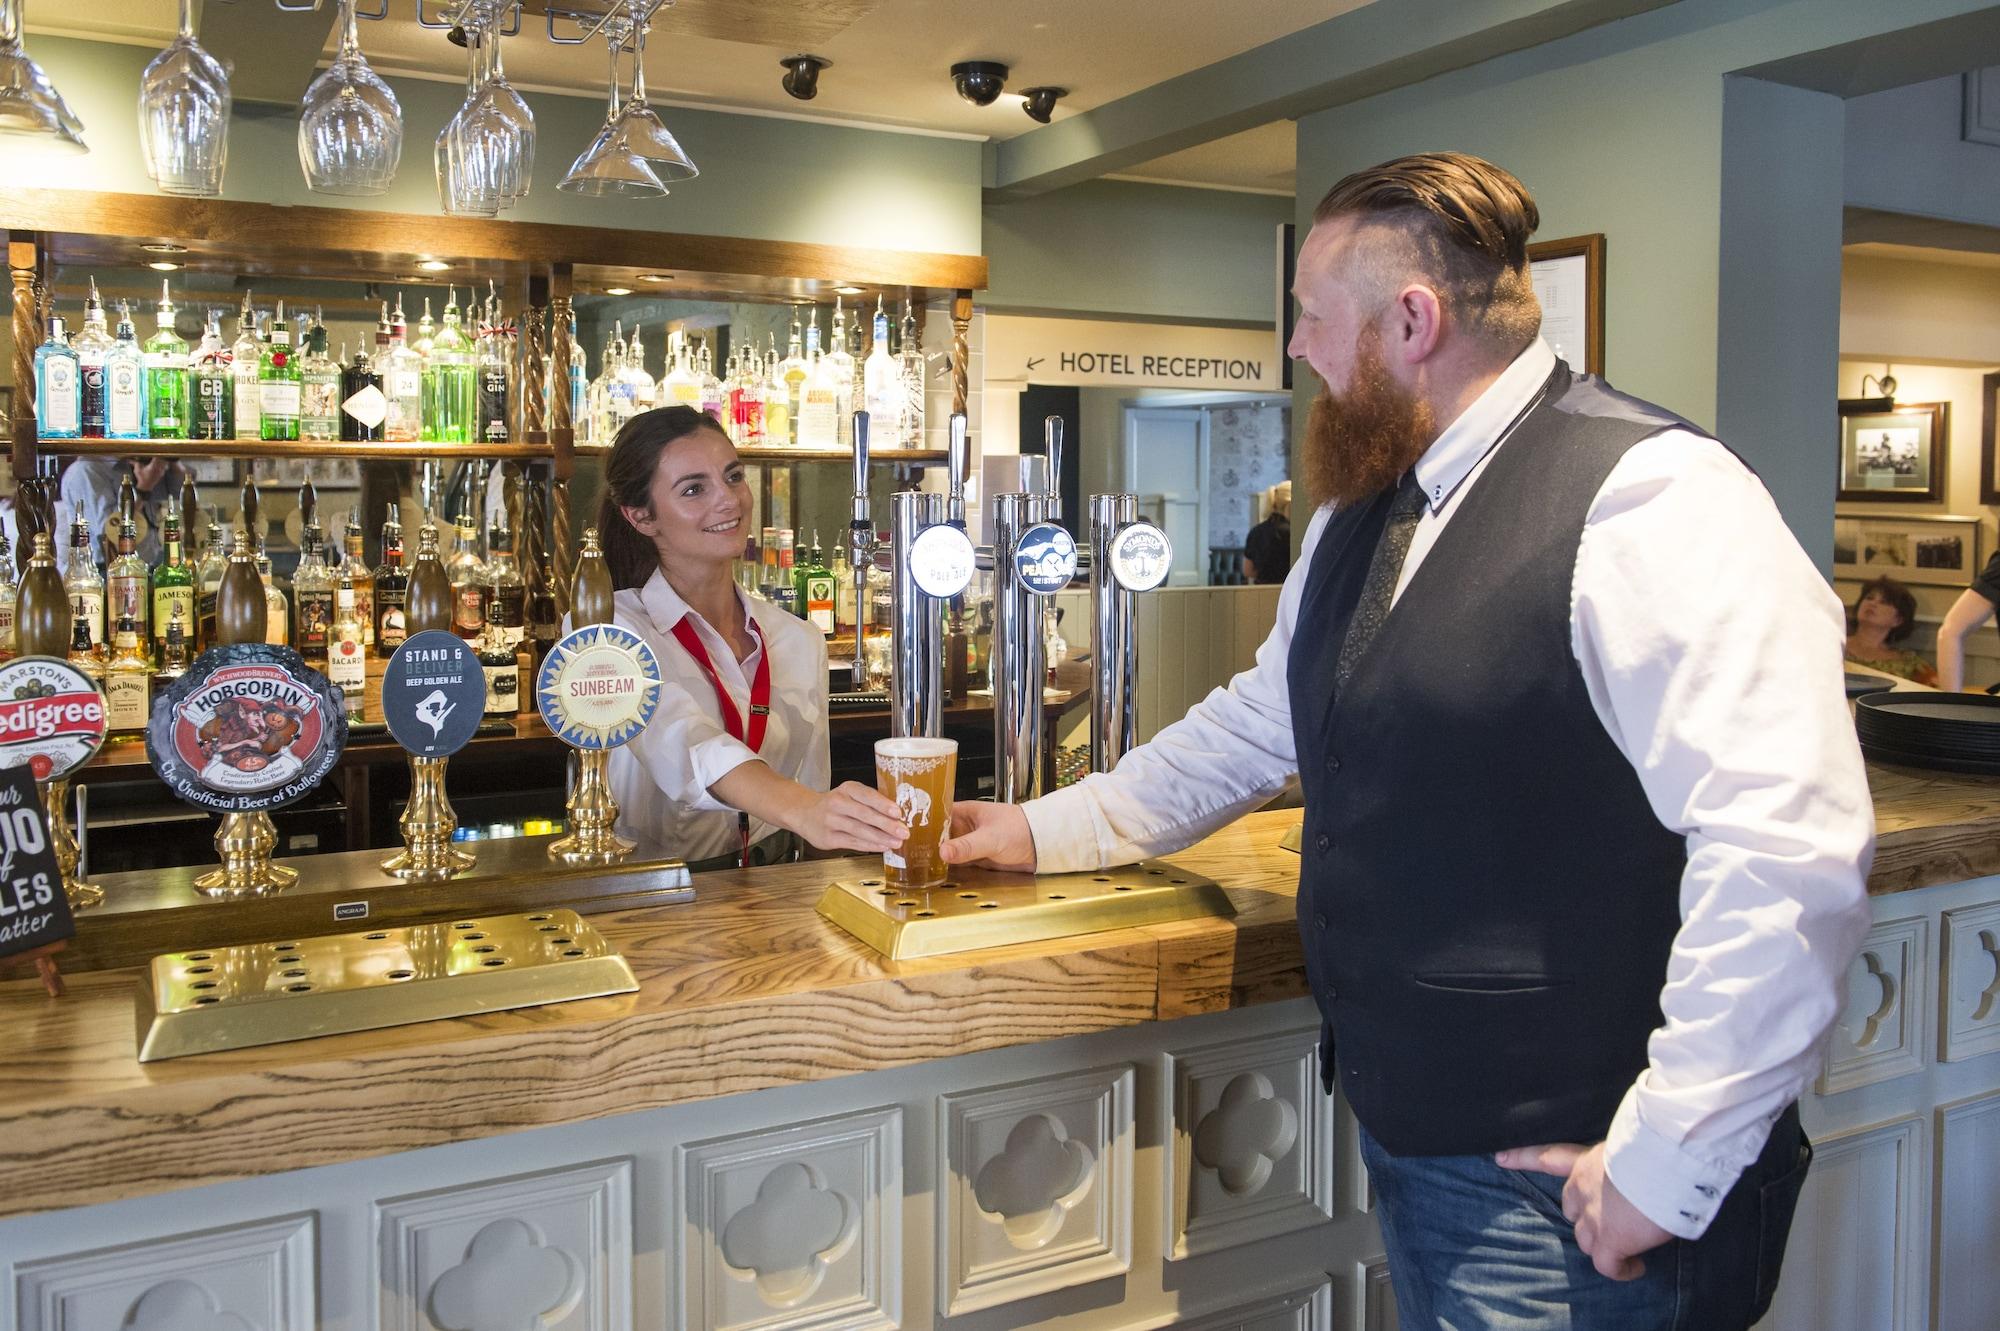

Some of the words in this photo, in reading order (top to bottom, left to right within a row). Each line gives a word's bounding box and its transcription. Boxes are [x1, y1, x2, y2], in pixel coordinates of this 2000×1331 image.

[1060, 352, 1135, 375] HOTEL
[1142, 355, 1262, 380] RECEPTION
[200, 379, 224, 396] GB
[402, 381, 412, 389] 24
[486, 384, 505, 392] GIN
[405, 648, 448, 663] STAND
[454, 648, 463, 660] &
[406, 661, 463, 675] DELIVER
[1, 666, 73, 693] MARSTON'S
[406, 678, 423, 687] DEEP
[424, 676, 449, 686] GOLDEN
[449, 675, 463, 684] ALE
[570, 678, 635, 697] SUNBEAM
[194, 680, 303, 712] HOBGOBLIN
[161, 759, 178, 784] The
[177, 778, 235, 810] Unofficial
[238, 796, 269, 810] Beer
[272, 790, 284, 803] of
[285, 749, 336, 798] Halloween
